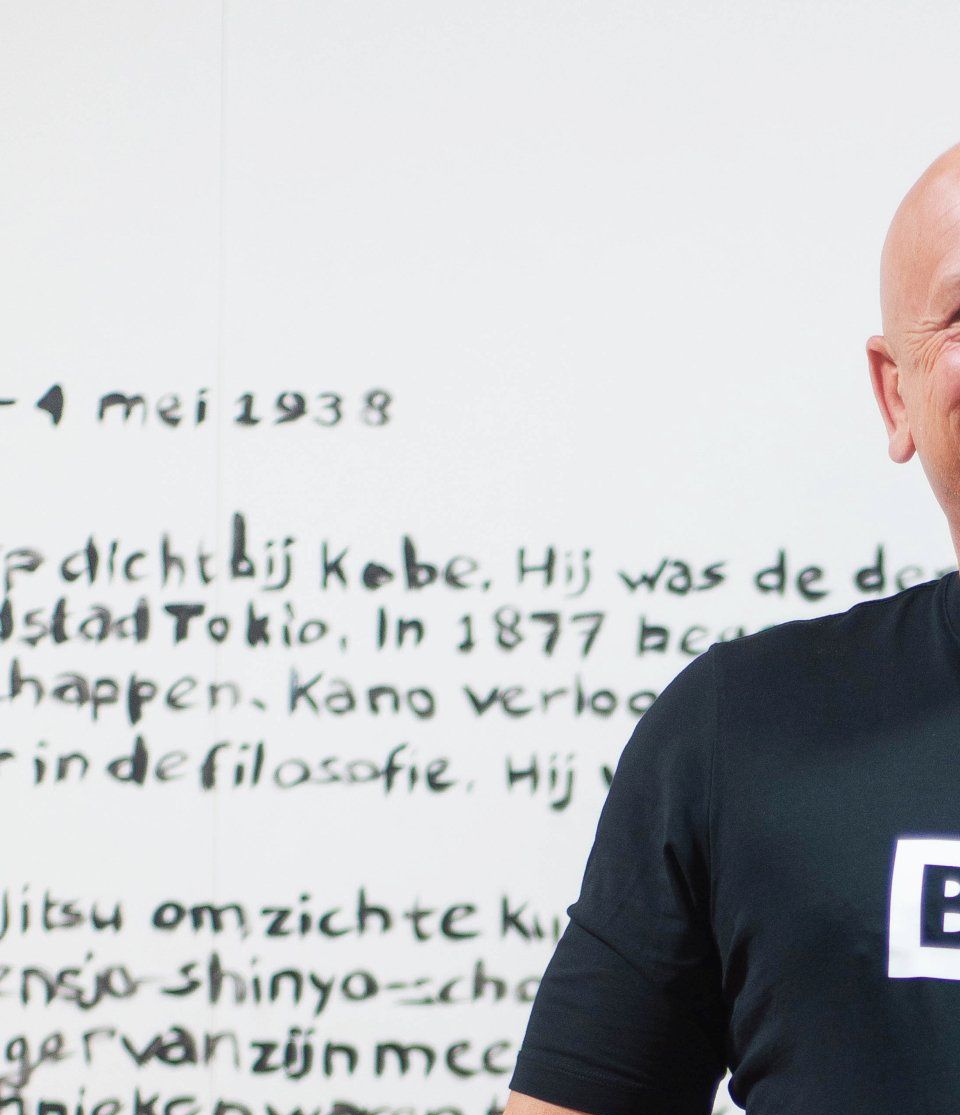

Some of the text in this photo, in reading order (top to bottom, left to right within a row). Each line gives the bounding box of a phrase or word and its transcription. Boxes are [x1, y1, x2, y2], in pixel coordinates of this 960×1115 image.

[98, 389, 207, 428] mei
[235, 389, 392, 427] 1938
[0, 543, 44, 597] p
[60, 534, 213, 585] dicht
[229, 512, 295, 591] bij
[518, 546, 591, 594] Hij
[618, 558, 726, 596] was
[753, 549, 829, 603] de
[377, 607, 425, 649] In
[457, 608, 605, 657] 1877
[0, 658, 265, 726] happen.
[289, 671, 436, 720] Kano
[506, 750, 575, 812] Hij
[151, 900, 249, 938] om
[260, 888, 393, 939] zich
[403, 895, 479, 943] te
[120, 1025, 240, 1068] van
[250, 1025, 359, 1082] zijn
